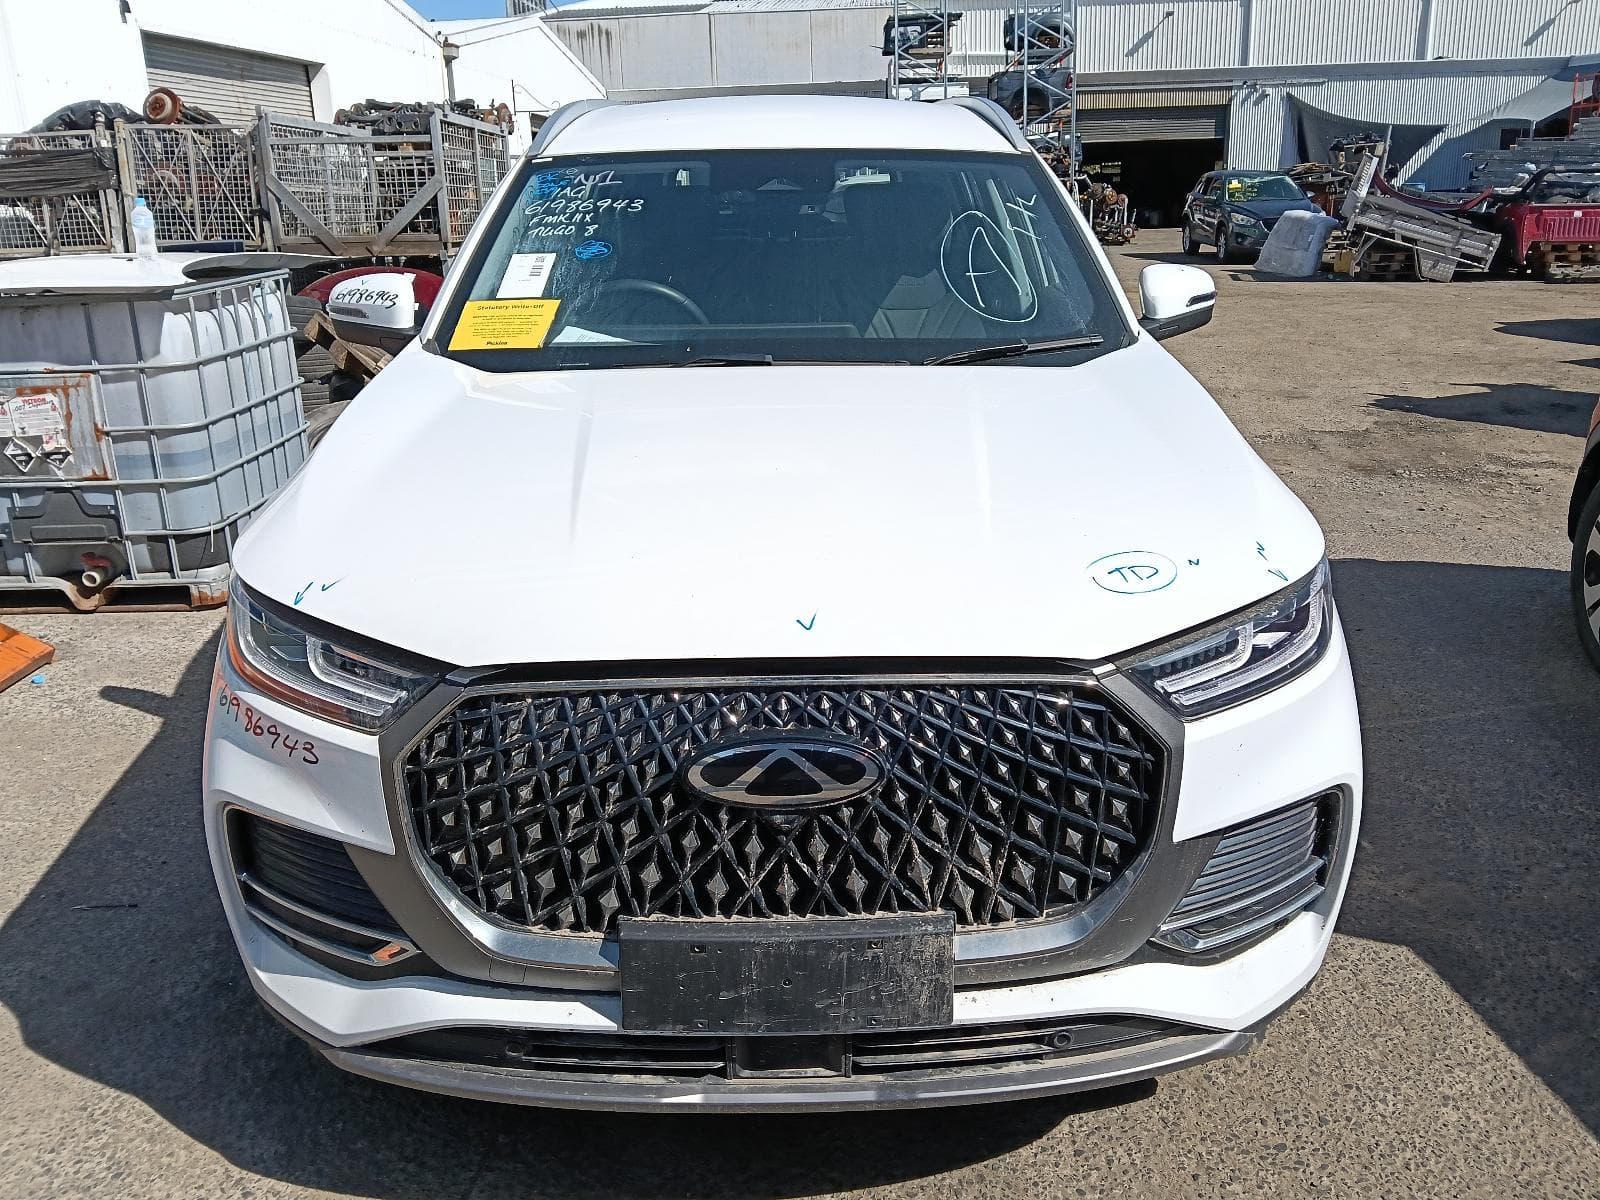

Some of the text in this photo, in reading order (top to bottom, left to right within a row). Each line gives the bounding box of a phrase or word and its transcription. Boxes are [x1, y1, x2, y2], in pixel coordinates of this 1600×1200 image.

[525, 199, 644, 215] 61986943
[584, 224, 599, 237] 8
[336, 288, 399, 309] 61986943
[1107, 565, 1159, 583] TD
[218, 683, 320, 765] 61986943
